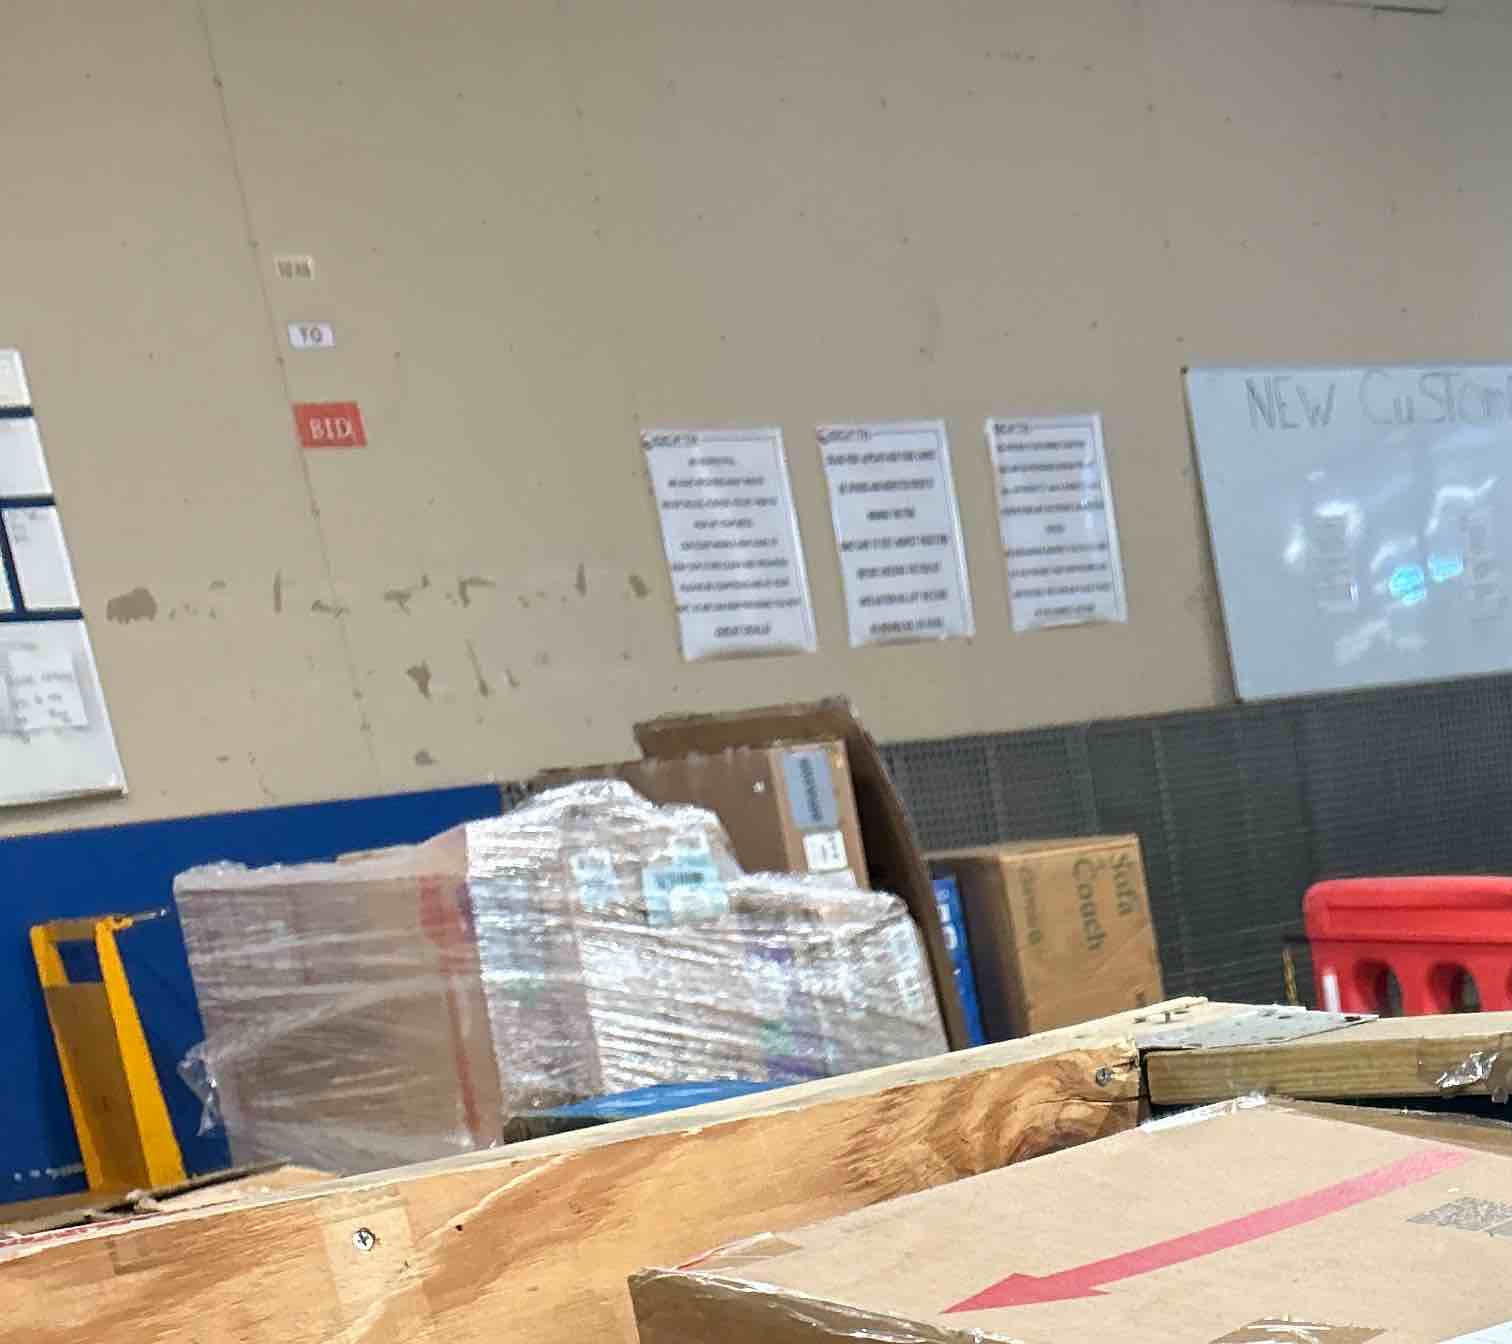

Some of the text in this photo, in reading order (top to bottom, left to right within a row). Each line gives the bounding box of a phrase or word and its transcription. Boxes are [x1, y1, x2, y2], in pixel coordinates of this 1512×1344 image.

[309, 417, 352, 440] BID
[1245, 376, 1336, 431] NEW
[1072, 856, 1109, 951] Couch
[1111, 852, 1139, 918] Sofa
